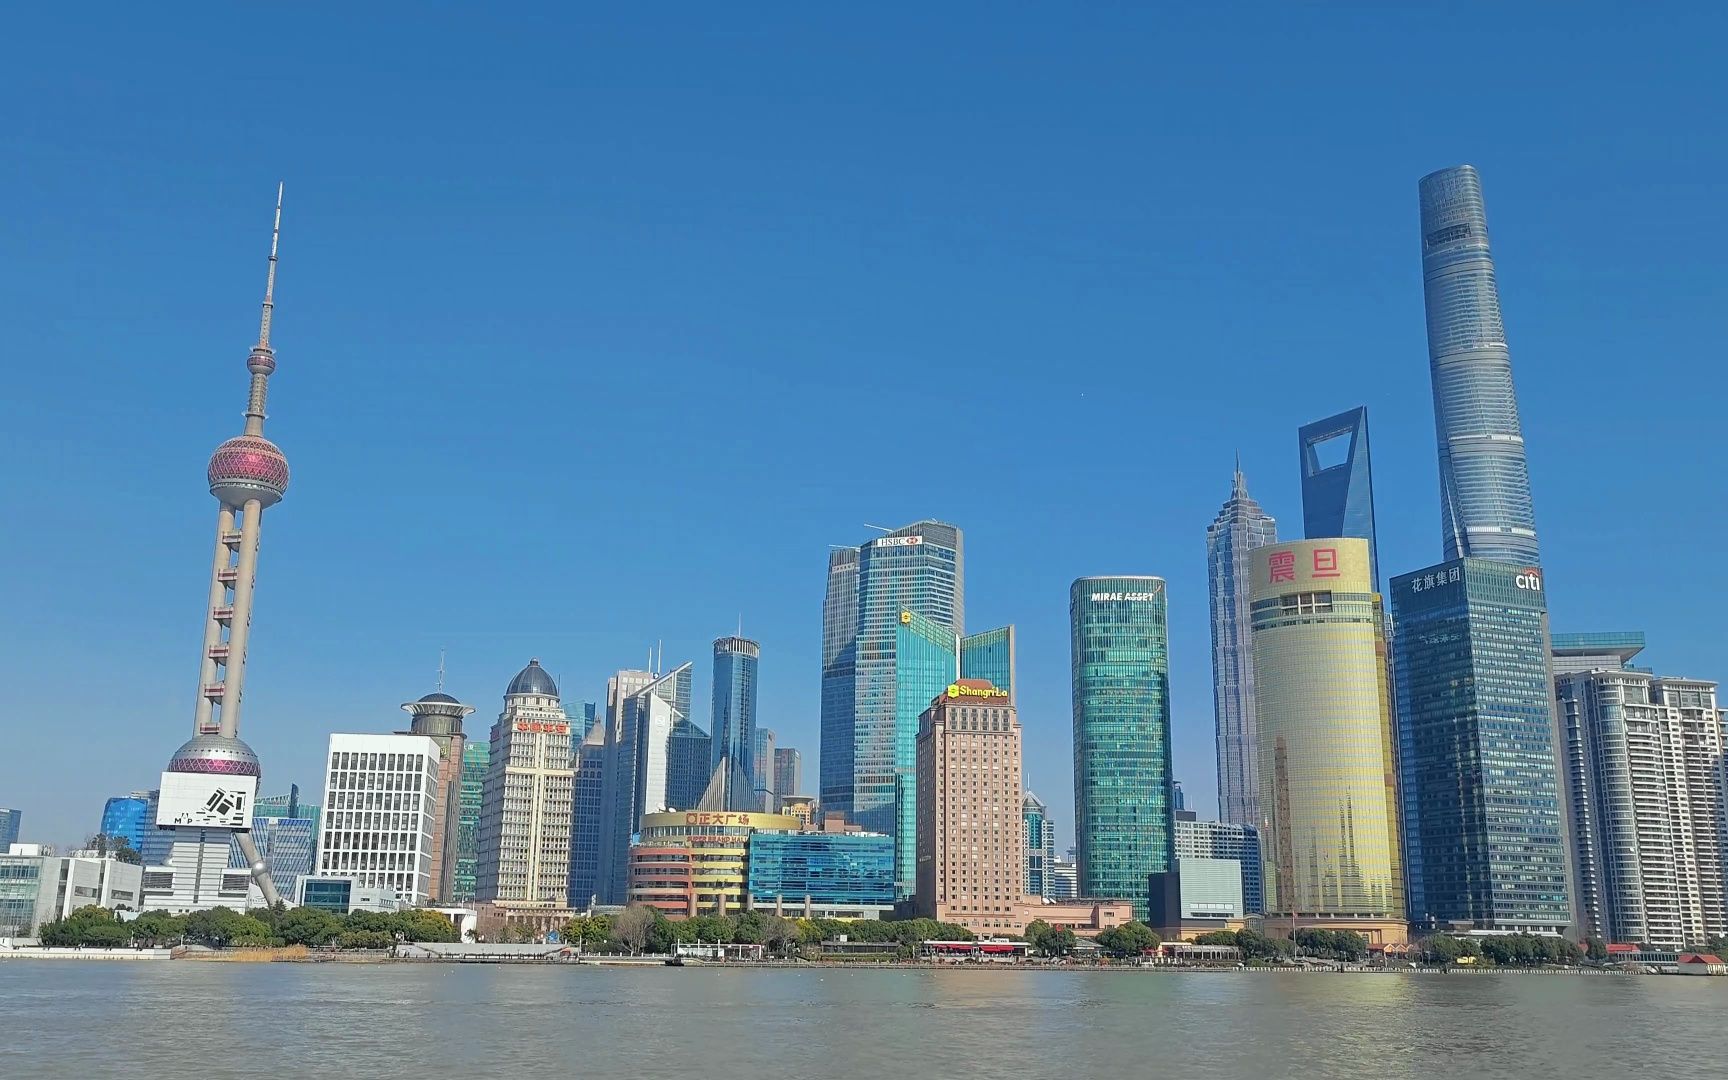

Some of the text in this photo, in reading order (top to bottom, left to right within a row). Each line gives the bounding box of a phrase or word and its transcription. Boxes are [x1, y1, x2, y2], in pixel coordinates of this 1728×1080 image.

[881, 538, 905, 546] HSBC
[1269, 548, 1341, 583] 震旦
[1411, 566, 1460, 593] 花旗集团
[1516, 573, 1540, 590] citi
[1091, 592, 1154, 602] MIRAE ASSET
[699, 813, 750, 825] 正大广场
